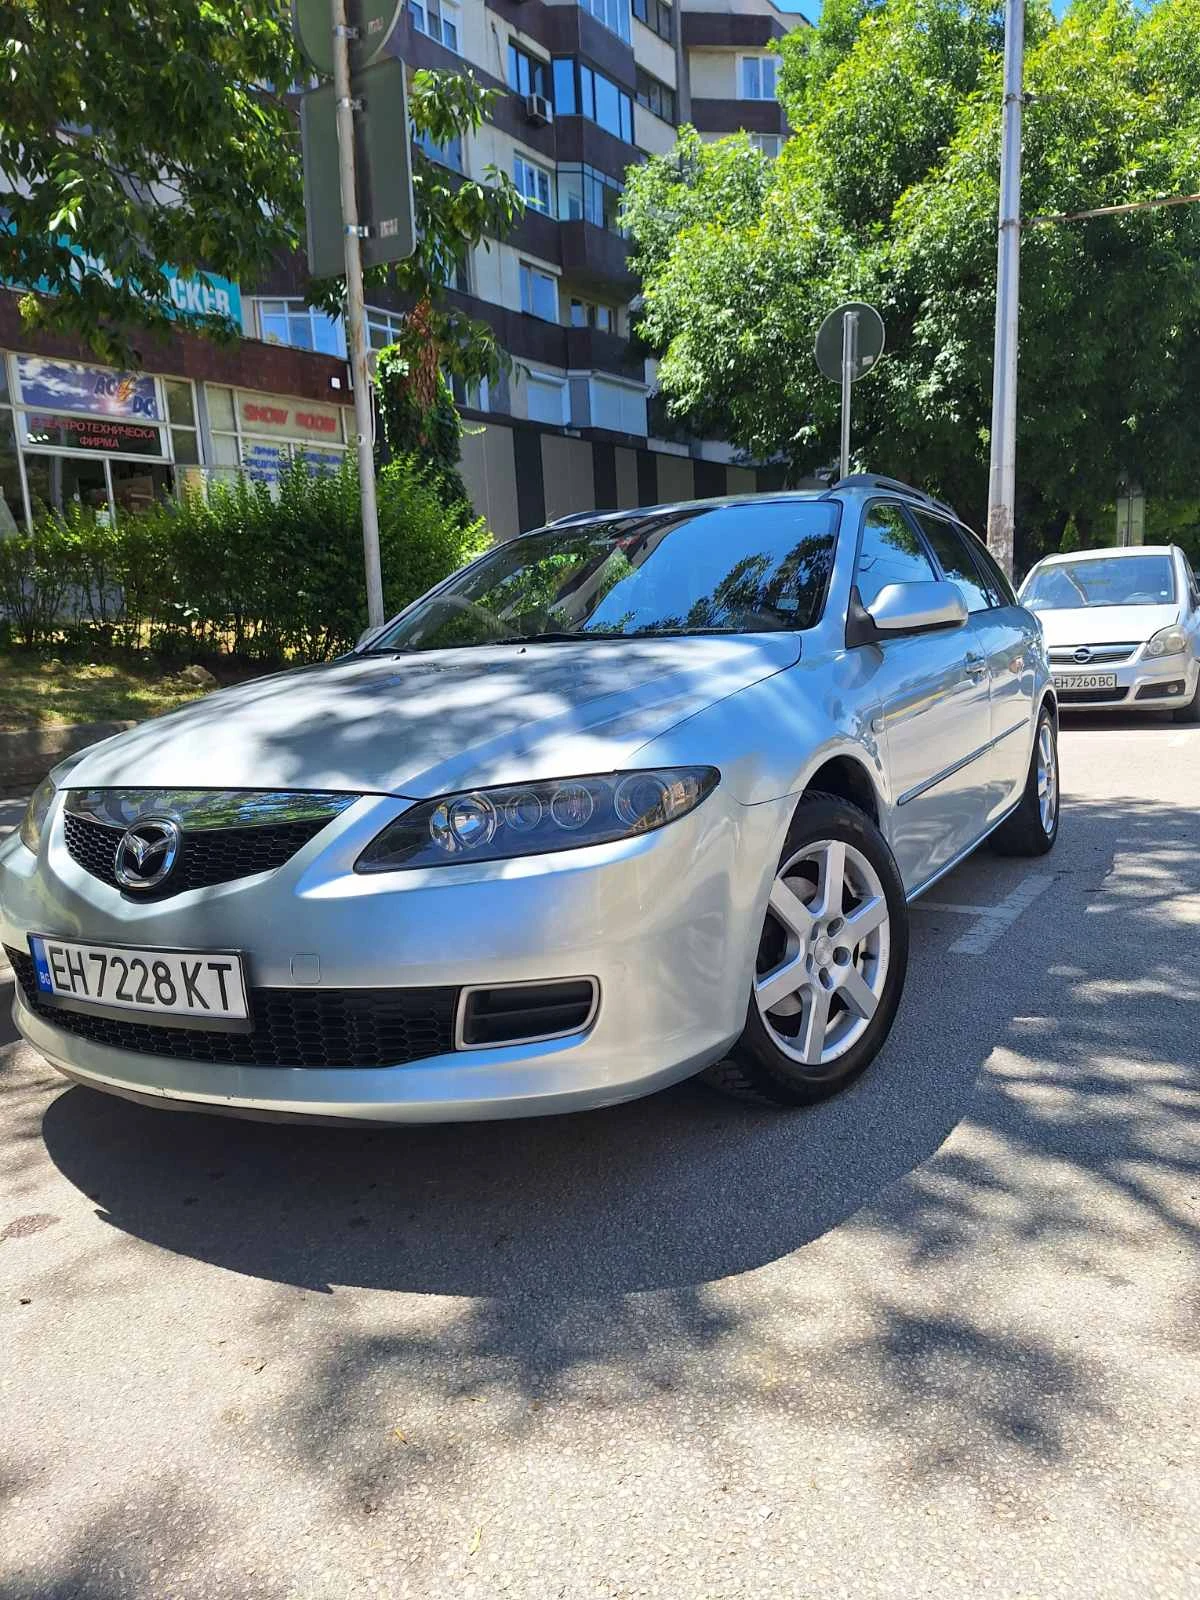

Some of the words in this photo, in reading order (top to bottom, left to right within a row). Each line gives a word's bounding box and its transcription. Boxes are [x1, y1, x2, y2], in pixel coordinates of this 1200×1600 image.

[132, 394, 156, 418] DC
[243, 403, 289, 426] SHOW
[295, 411, 337, 433] ROOM
[79, 436, 120, 449] ФИРМА
[40, 971, 51, 985] BG
